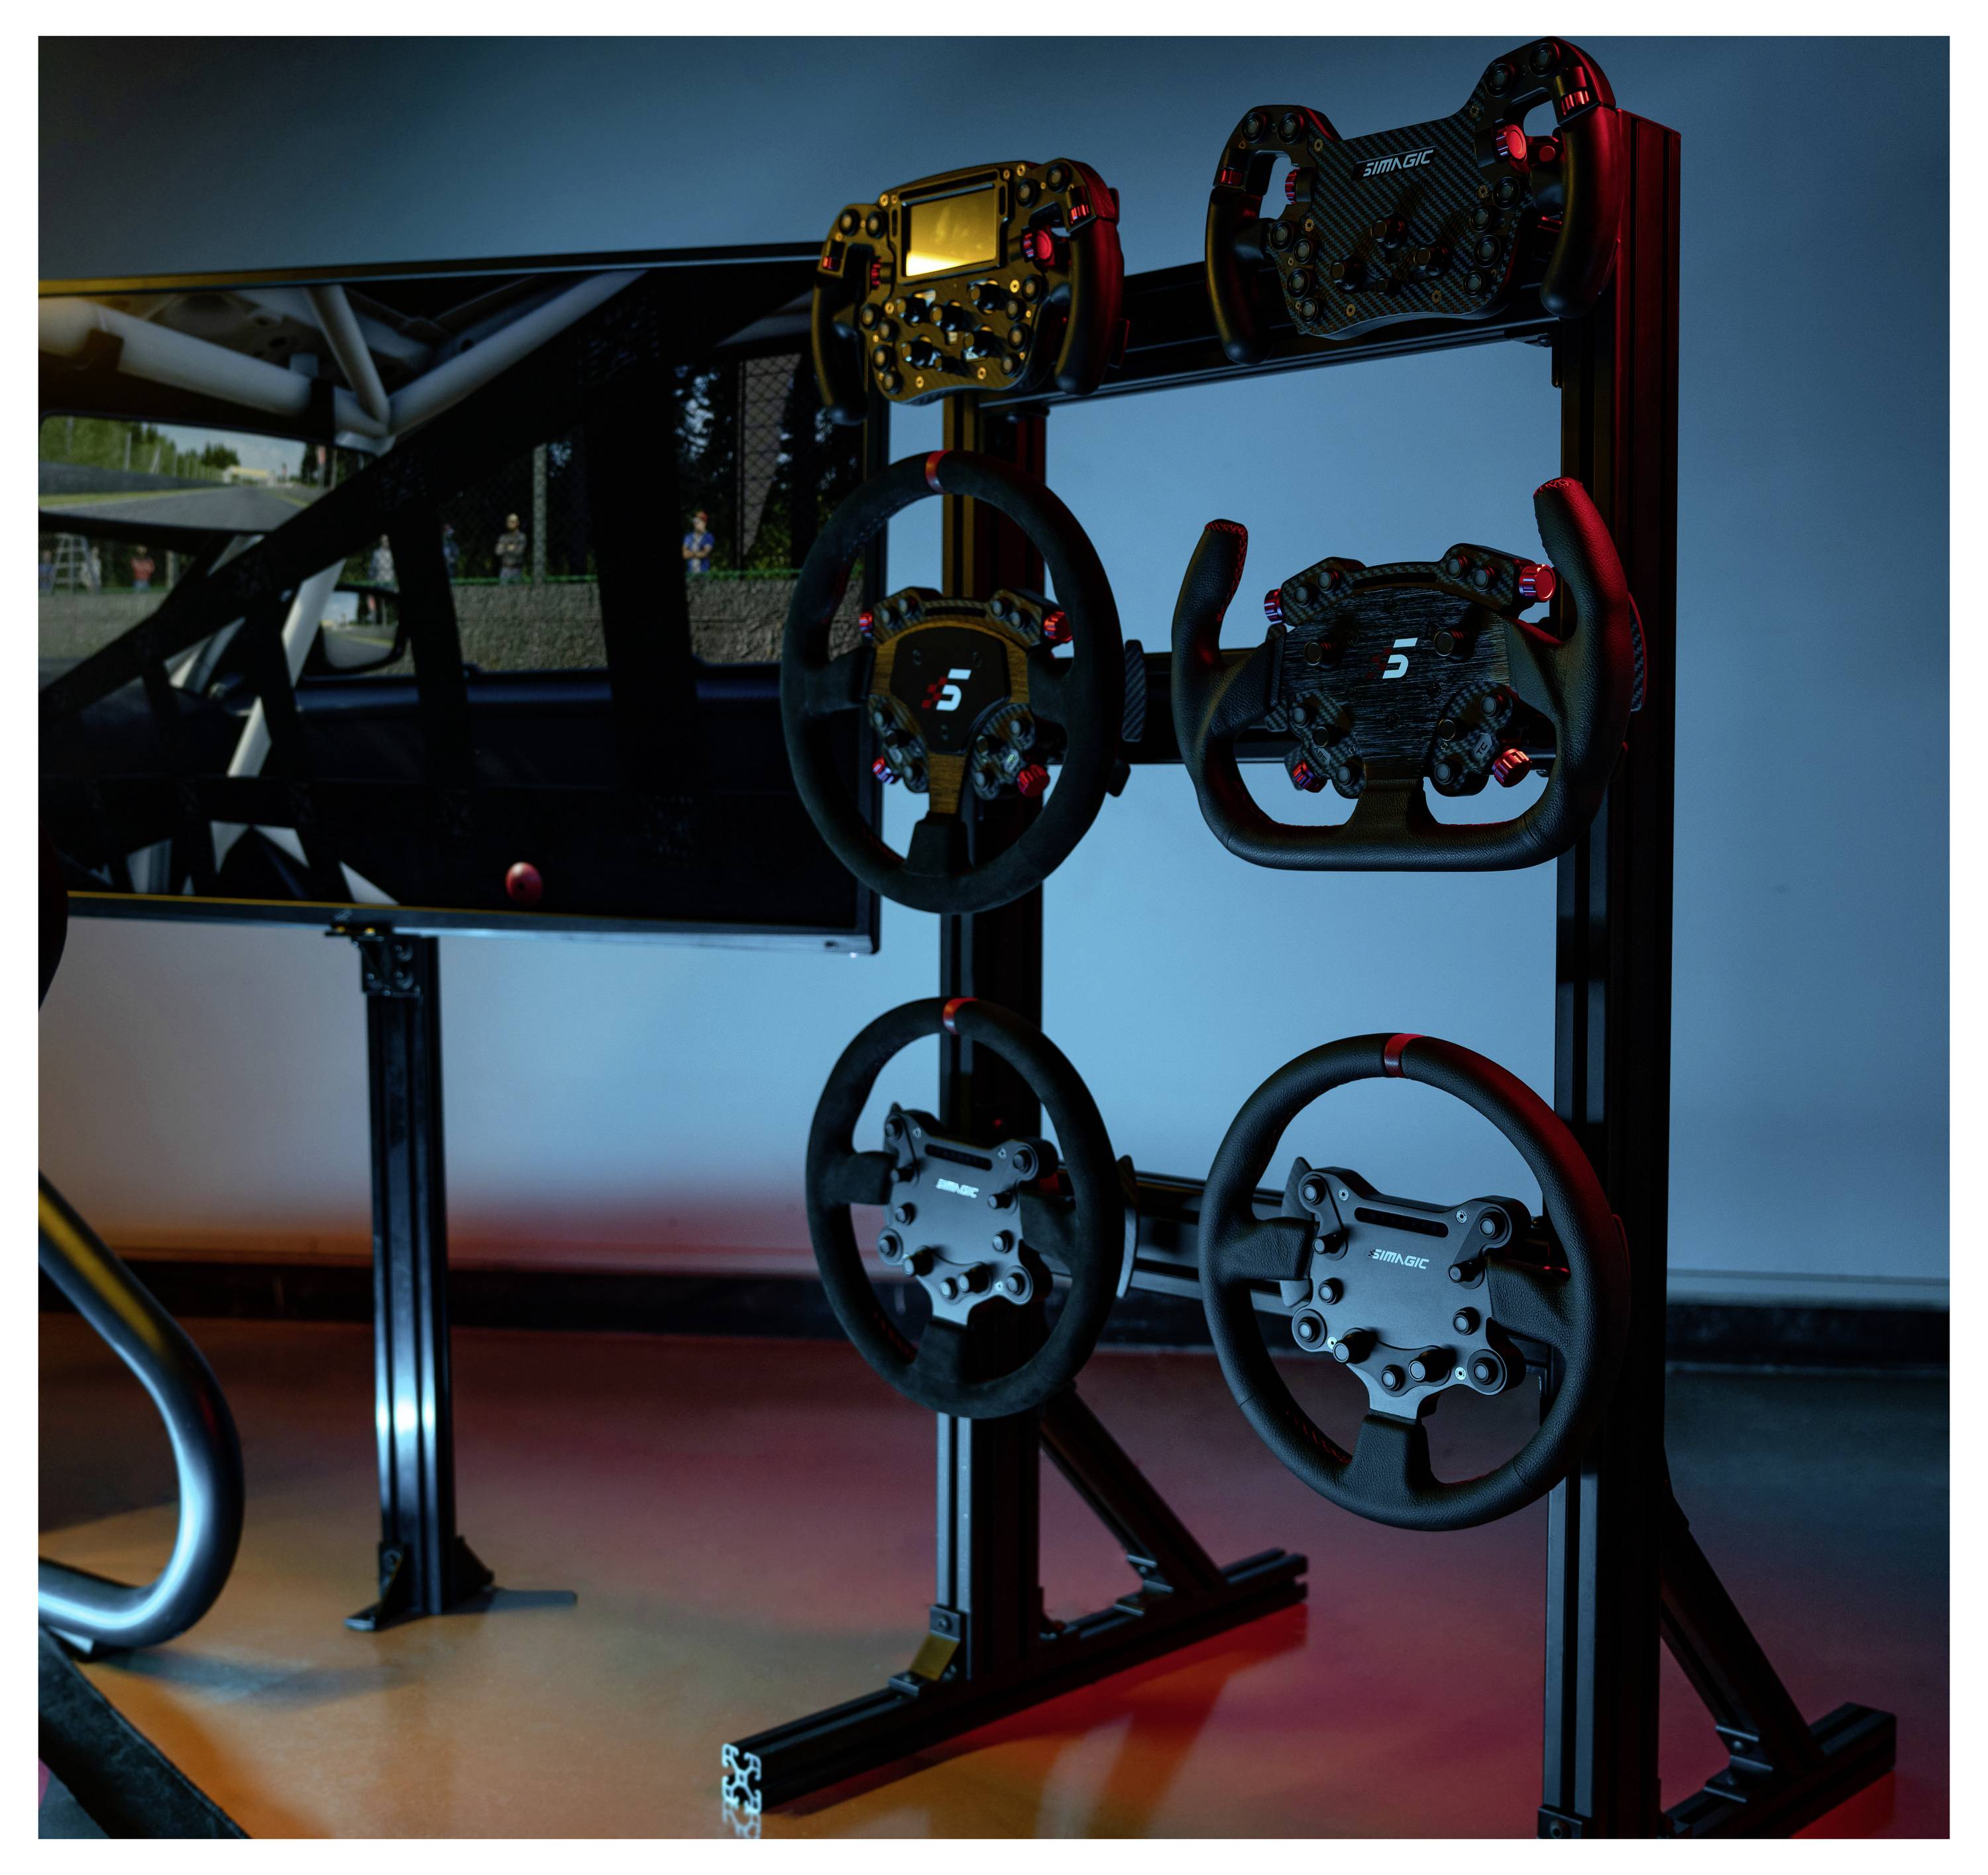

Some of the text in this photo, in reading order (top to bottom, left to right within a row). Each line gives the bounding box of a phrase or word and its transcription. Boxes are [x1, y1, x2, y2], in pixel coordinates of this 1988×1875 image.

[1362, 149, 1434, 178] SIMAGIC
[1314, 747, 1327, 763] ABS
[1476, 741, 1488, 755] TC
[1372, 1248, 1429, 1270] SIMAGIC
